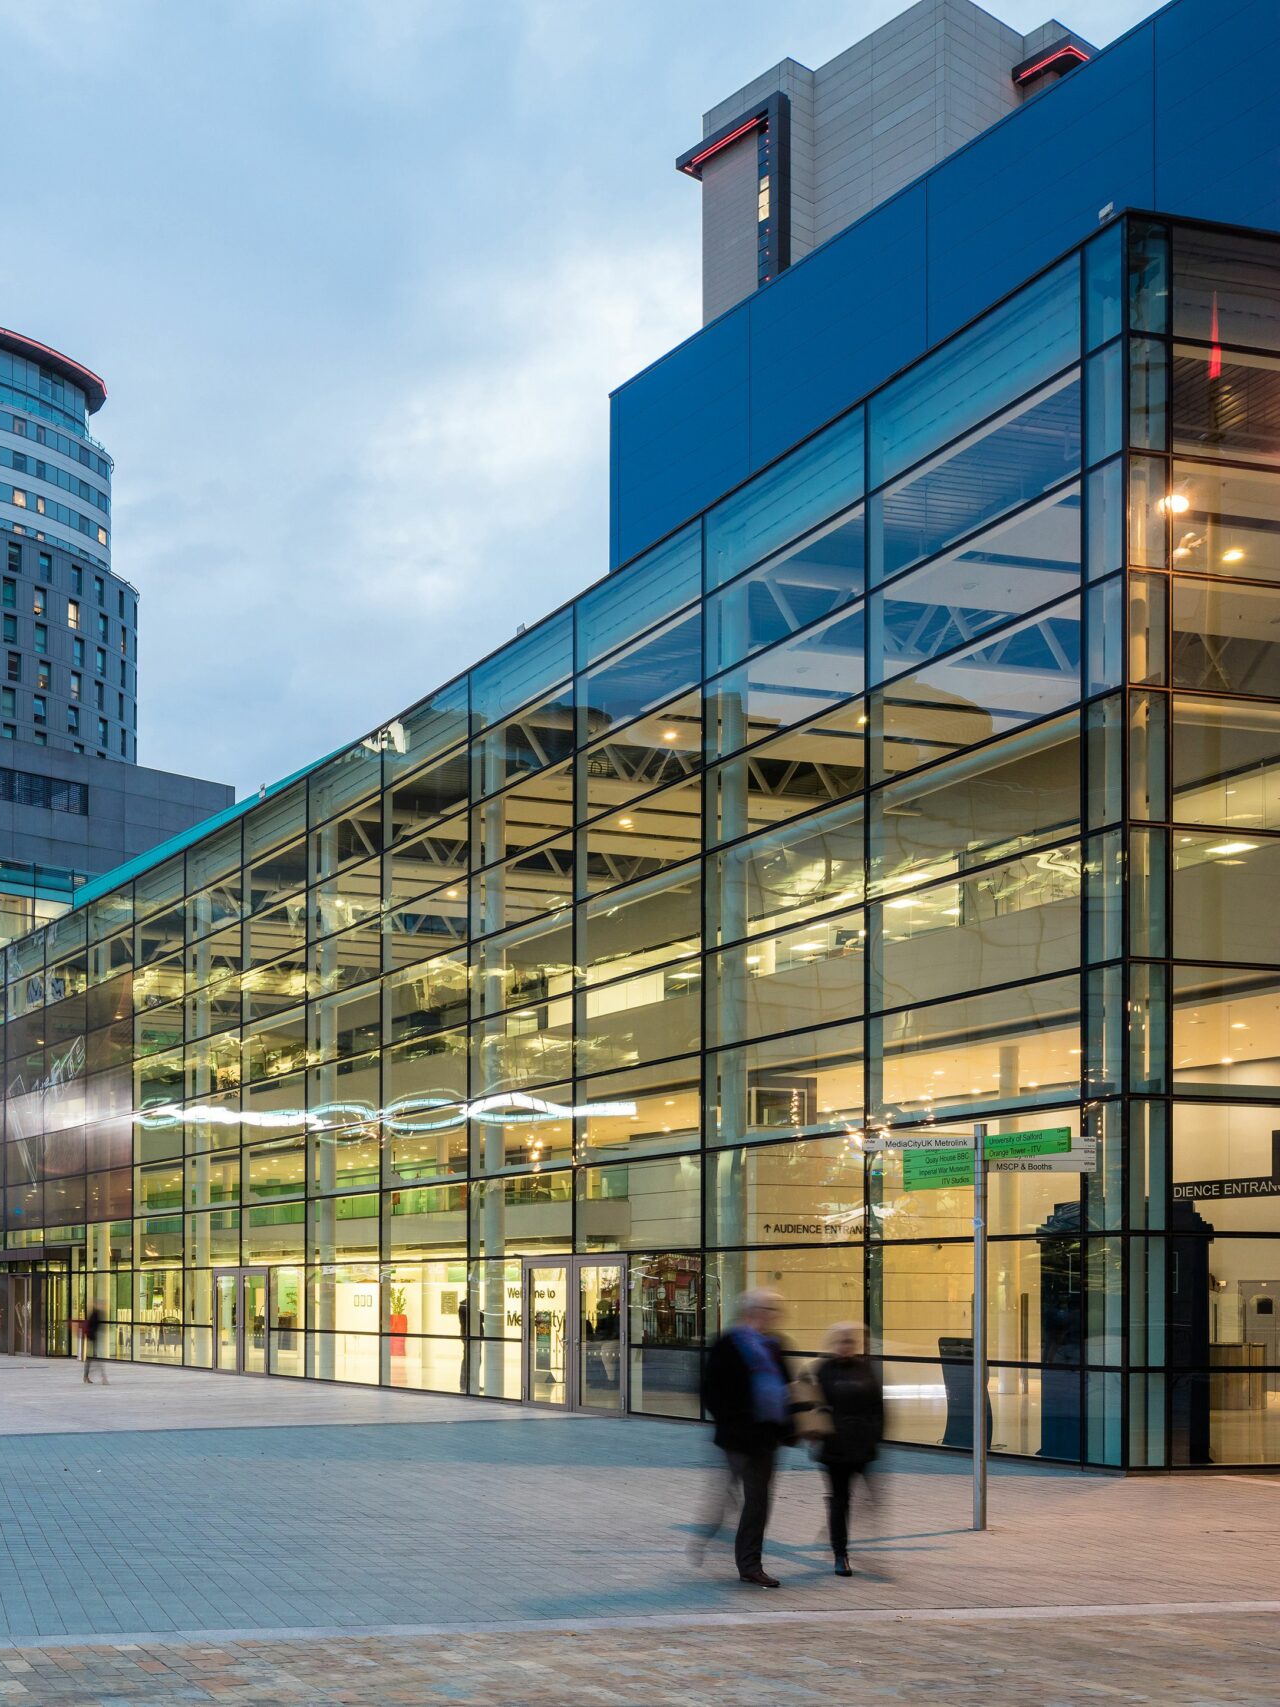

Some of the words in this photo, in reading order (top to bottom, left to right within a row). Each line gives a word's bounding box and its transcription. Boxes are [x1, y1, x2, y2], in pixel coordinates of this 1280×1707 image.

[885, 1139, 933, 1149] MediaCityUK
[934, 1138, 968, 1147] Metrolink
[989, 1135, 1016, 1146] University
[1016, 1134, 1022, 1142] of
[1023, 1132, 1043, 1141] Salford
[989, 1148, 1009, 1158] Orange
[1010, 1147, 1026, 1155] Tower
[1031, 1145, 1042, 1153] ITV
[925, 1155, 939, 1165] Quay
[939, 1153, 957, 1162] House
[957, 1152, 970, 1161] BBC
[919, 1168, 938, 1177] Imperial
[938, 1166, 949, 1175] War
[949, 1165, 970, 1174] Museum
[996, 1163, 1019, 1171] MSCP
[1020, 1163, 1026, 1171] &
[1028, 1163, 1053, 1171] Booths
[941, 1177, 951, 1185] ITV
[951, 1176, 970, 1185] Studios
[773, 1223, 822, 1234] AUDIENCE
[547, 1288, 556, 1299] to
